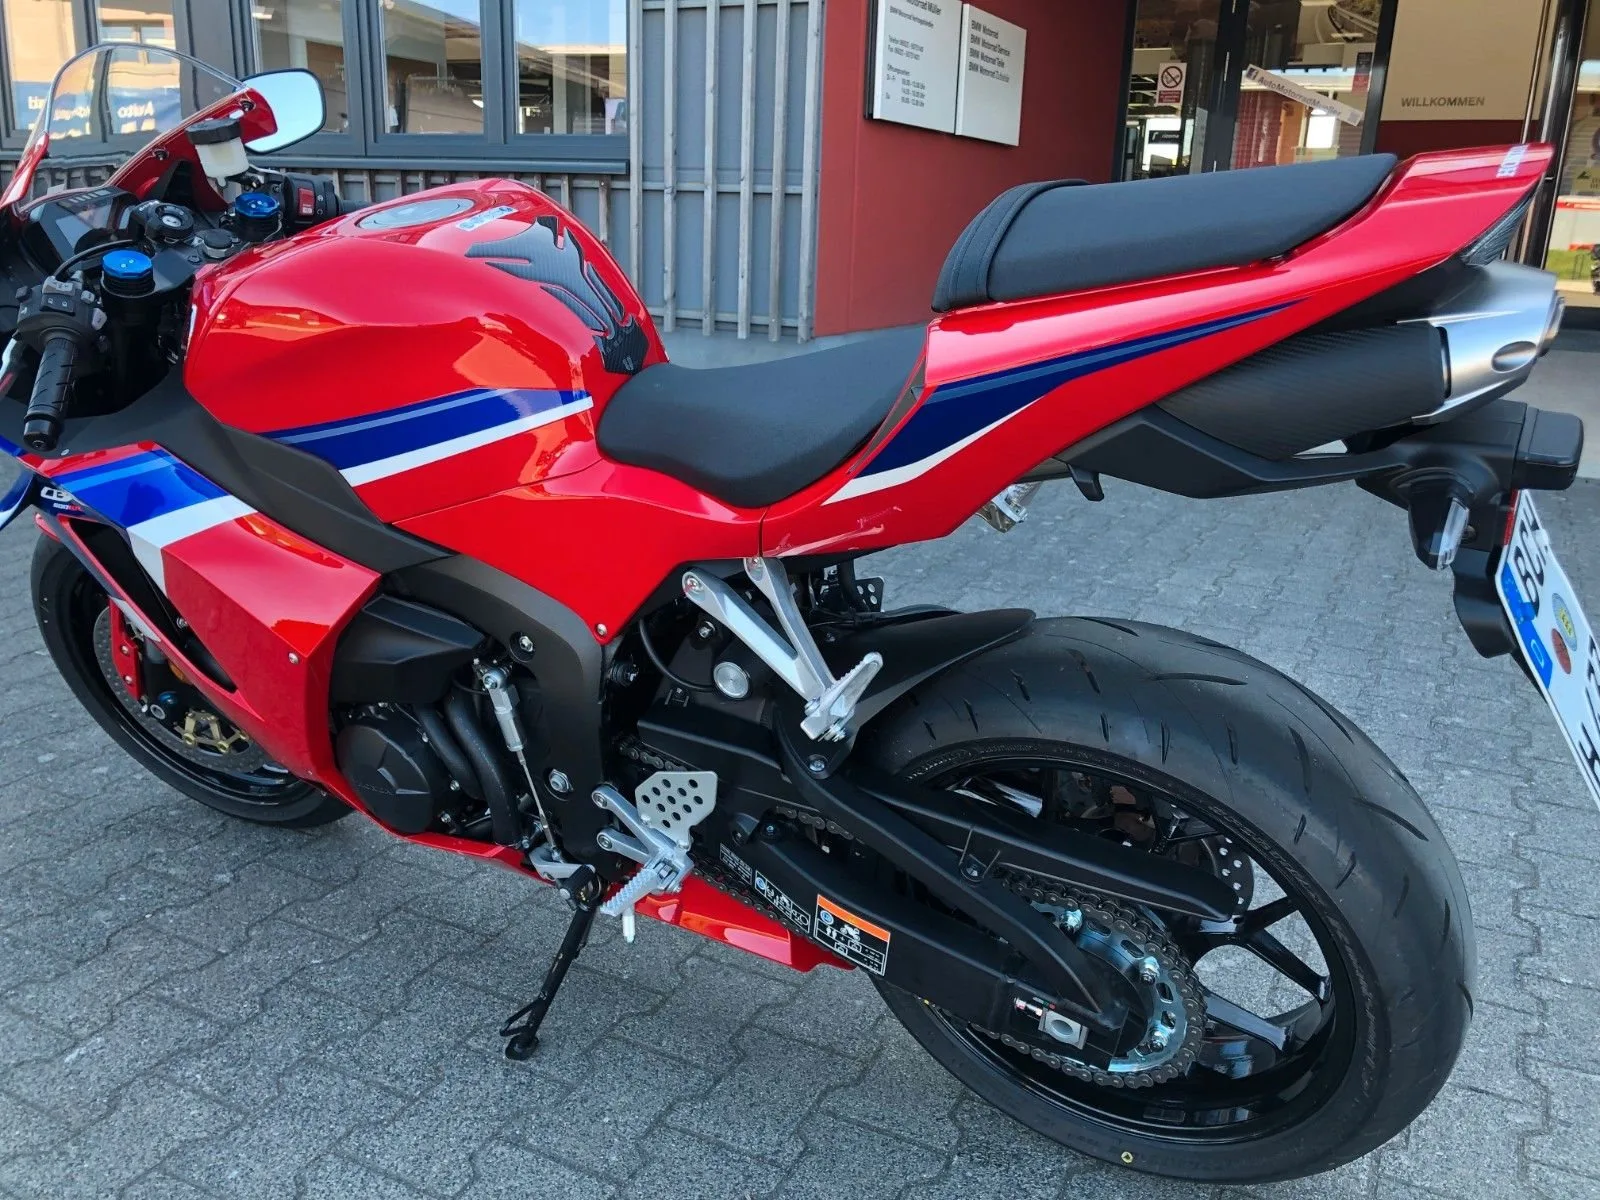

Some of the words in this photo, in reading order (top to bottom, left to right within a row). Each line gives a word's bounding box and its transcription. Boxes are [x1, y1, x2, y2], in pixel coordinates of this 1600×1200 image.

[971, 20, 981, 32] BMW
[982, 24, 998, 39] Motorrad
[970, 34, 980, 45] BMW
[981, 38, 998, 52] Motorrad
[969, 48, 979, 59] BMW
[980, 52, 996, 65] Motorrad
[968, 62, 978, 72] BMW
[1401, 96, 1485, 107] WILLKOMMEN
